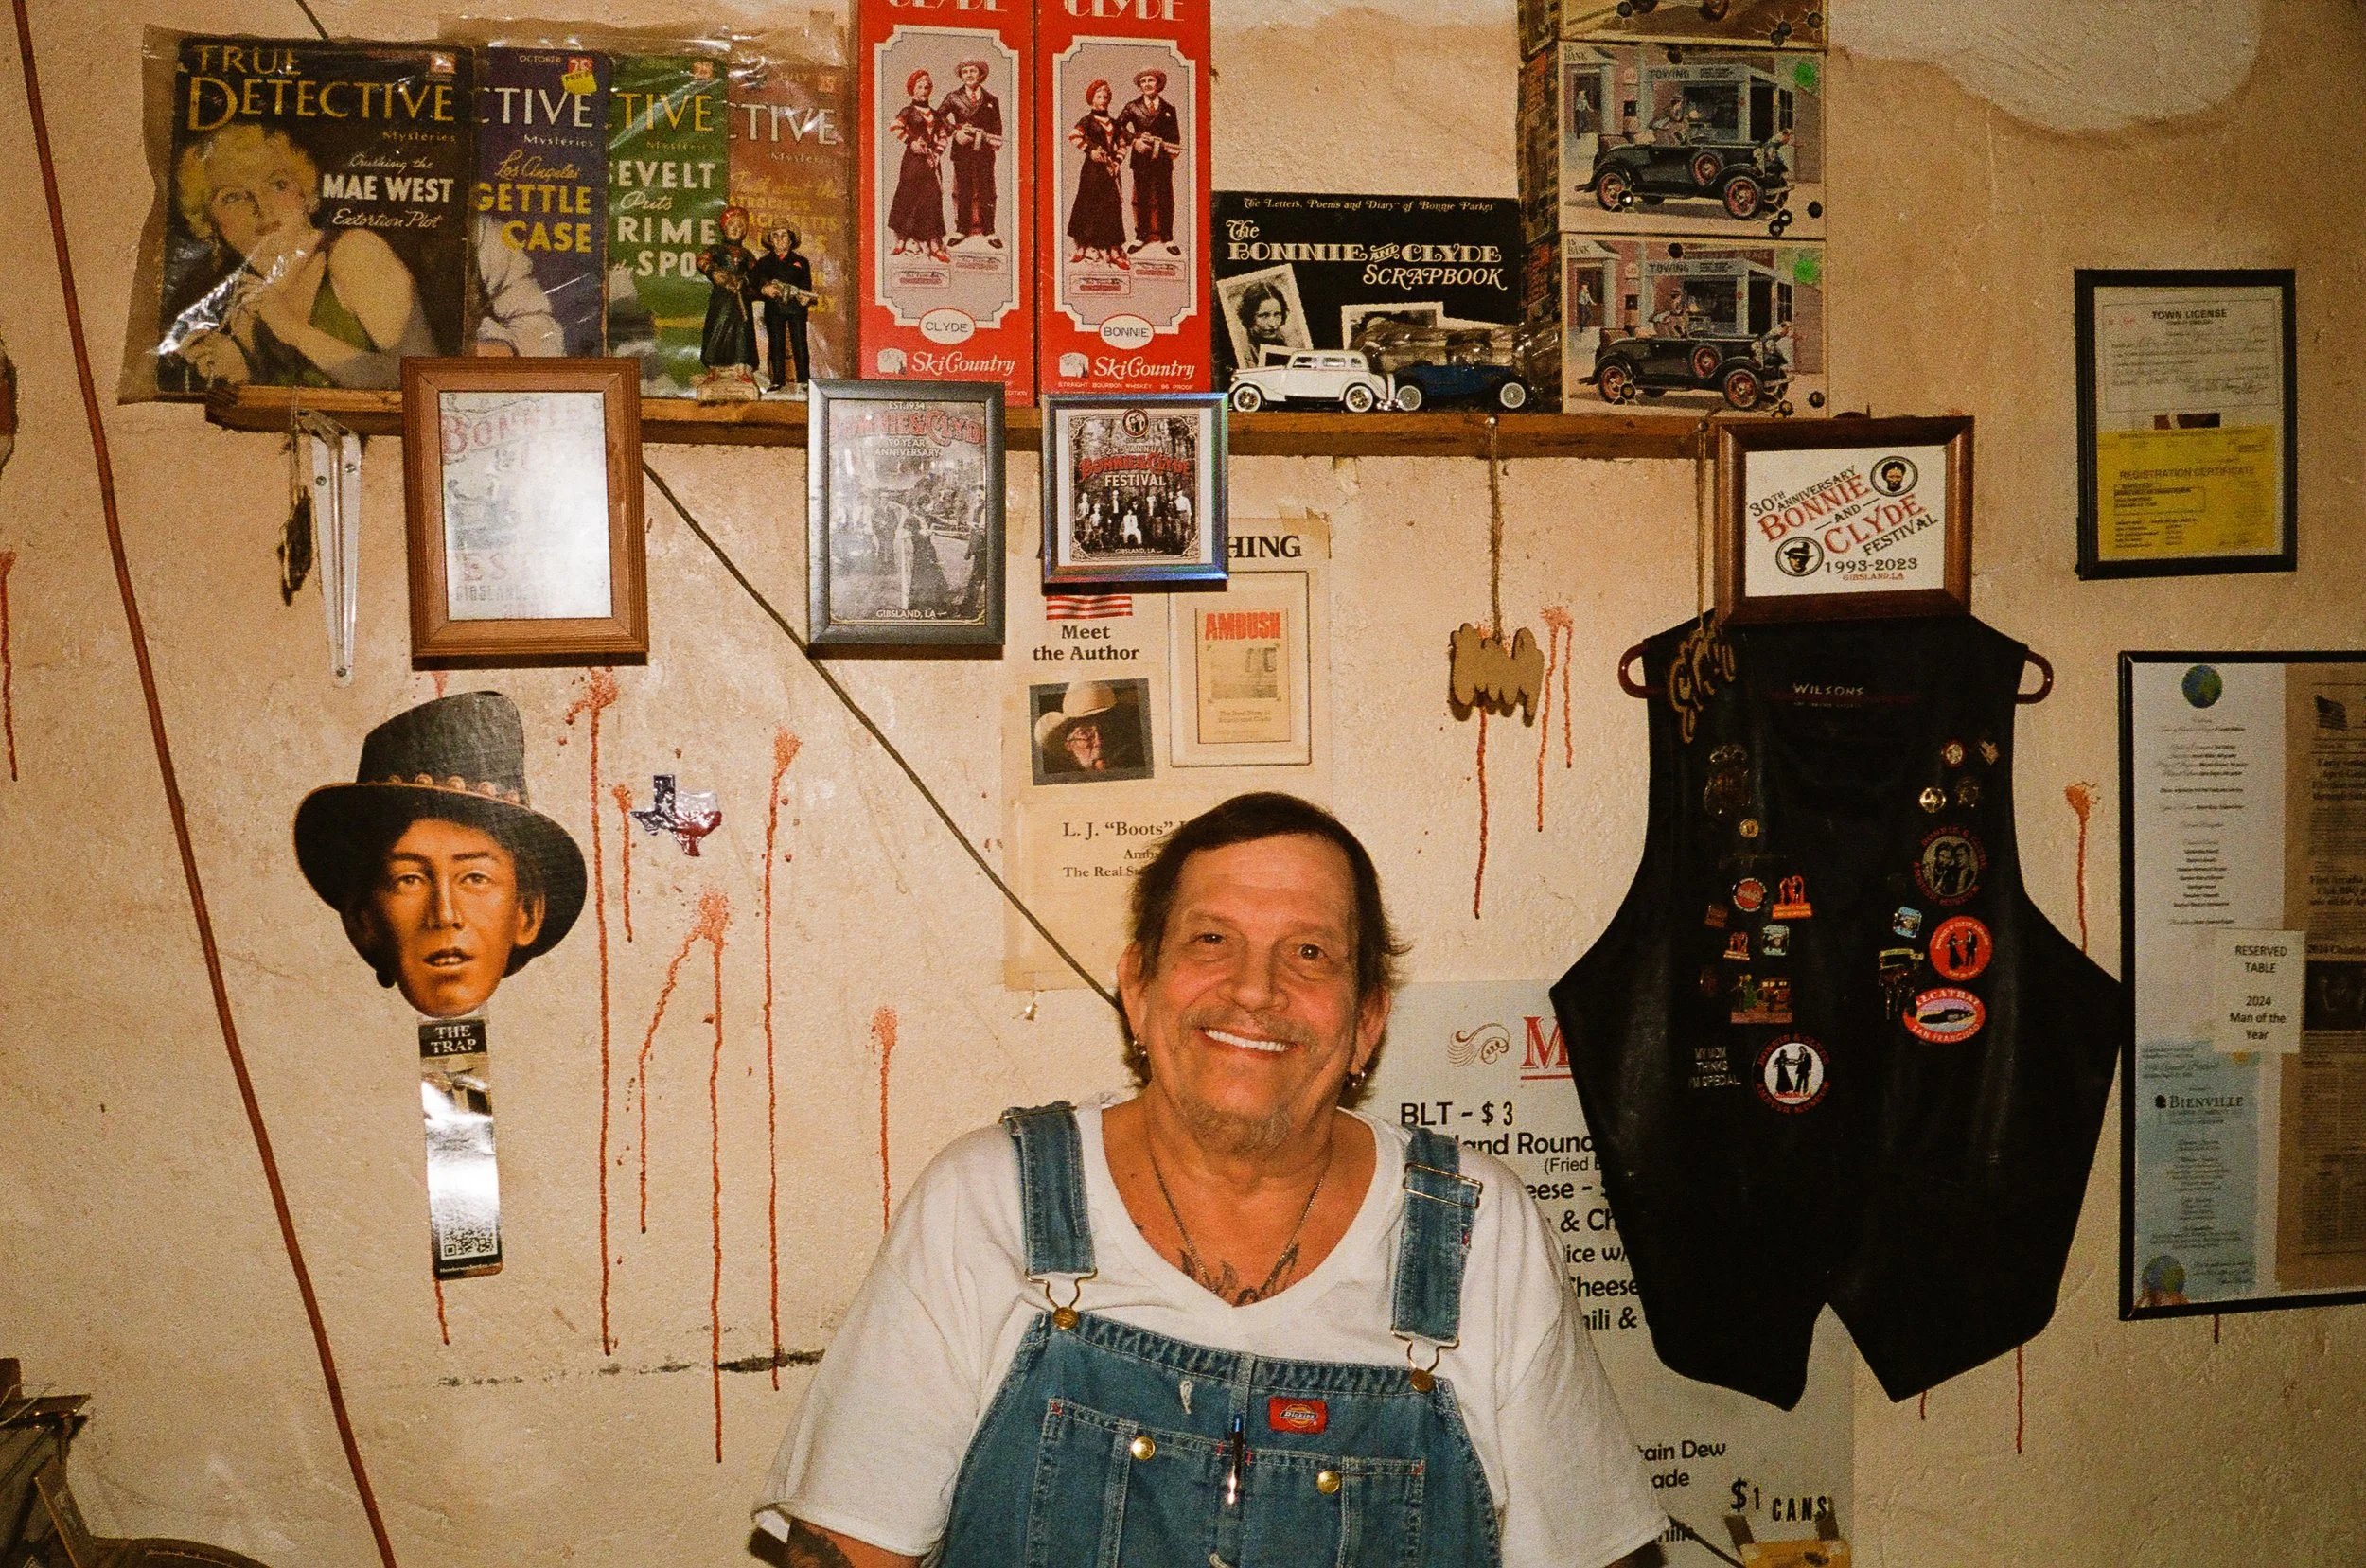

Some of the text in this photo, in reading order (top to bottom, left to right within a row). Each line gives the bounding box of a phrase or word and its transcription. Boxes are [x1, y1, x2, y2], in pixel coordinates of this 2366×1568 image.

[193, 45, 301, 76] TRUE
[520, 55, 562, 63] OCTOBER
[1650, 68, 1689, 79] TOWING
[189, 76, 454, 131] DETECTIVE
[483, 87, 592, 128] TIVE
[606, 93, 714, 132] TIVE
[730, 102, 837, 145] TIVE
[382, 131, 456, 143] Mysteries
[523, 133, 594, 148] Mysteries
[412, 156, 433, 169] the
[323, 173, 454, 203] MAE WEST
[476, 182, 592, 214] GETTLE
[1307, 200, 1341, 210] Poems
[1344, 200, 1362, 211] and
[1366, 200, 1401, 212] Diary
[1403, 201, 1414, 213] of
[1419, 201, 1456, 213] Bonnie
[1459, 202, 1495, 214] Parker
[332, 207, 442, 228] Extortion Plot
[501, 220, 592, 253] CASE
[1226, 220, 1260, 240] The
[1228, 242, 1502, 262] BONNIE AND CLYDE
[1650, 261, 1689, 273] TOWING
[1363, 263, 1508, 291] SCRAPBOOK
[2151, 308, 2227, 320] TOWN LICENSE
[925, 320, 969, 333] CLYDE
[1104, 326, 1150, 339] BONNIE
[902, 438, 927, 448] YEAR
[874, 448, 941, 457] ANNIVERSARY
[1104, 474, 1166, 486] FESTIVAL
[2119, 468, 2191, 479] REGISTRATION
[1777, 465, 1856, 512] ANNIVERSARY
[1757, 474, 1873, 543] BONNIE
[1834, 503, 1861, 523] AND
[1824, 492, 1927, 555] CLYDE
[1863, 513, 1938, 556] FESTIVAL
[1824, 557, 1918, 574] 1993-2023
[875, 608, 937, 619] GIBSLAND, LA
[1061, 625, 1110, 640] Meet
[1205, 611, 1281, 641] AMBUSH
[1033, 645, 1140, 661] the Author
[1792, 682, 1864, 696] WILSONS
[1062, 822, 1082, 837] L.
[1085, 821, 1099, 840] J.
[1063, 866, 1089, 878] The
[1094, 866, 1122, 877] Real
[2234, 945, 2287, 958] RESERVED
[2245, 961, 2276, 974] TABLE
[2245, 995, 2272, 1007] 2024
[2230, 1012, 2287, 1024] Man of the
[435, 1025, 471, 1039] THE
[2246, 1030, 2269, 1041] Year
[431, 1038, 477, 1054] TRAP
[2169, 1095, 2244, 1108] BIENVILLE
[1401, 1101, 1453, 1126] BLT
[1544, 1157, 1589, 1175] (Fried
[1560, 1209, 1580, 1233] &
[1571, 1276, 1638, 1297] heese
[1618, 1306, 1637, 1329] &
[1681, 1439, 1726, 1459] Dew
[1772, 1495, 1828, 1523] CANS
